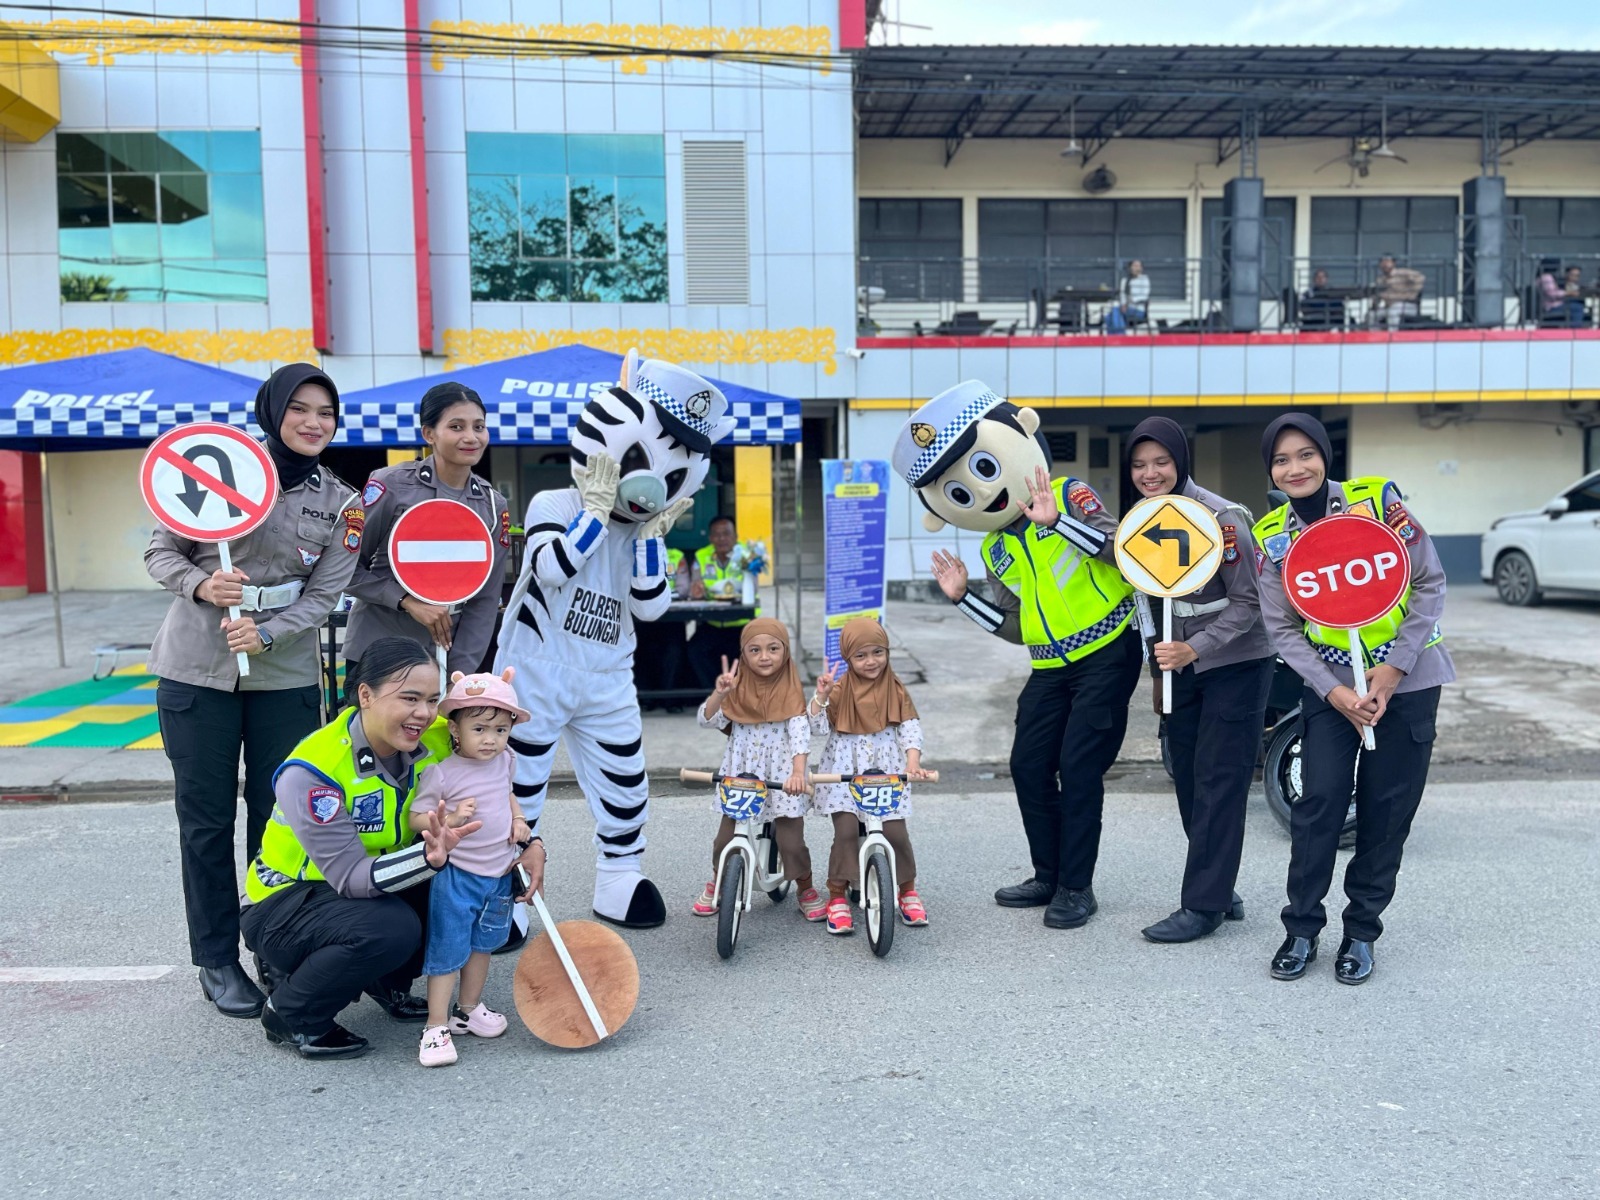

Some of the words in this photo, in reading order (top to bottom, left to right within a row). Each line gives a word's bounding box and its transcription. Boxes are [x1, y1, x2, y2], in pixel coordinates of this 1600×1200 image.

[500, 378, 622, 399] POLIS
[1038, 529, 1054, 539] POL
[1295, 551, 1398, 599] STOP
[571, 587, 621, 623] POLRESTA
[563, 609, 621, 646] BULUNGAN
[725, 789, 758, 811] 27
[861, 786, 893, 807] 28
